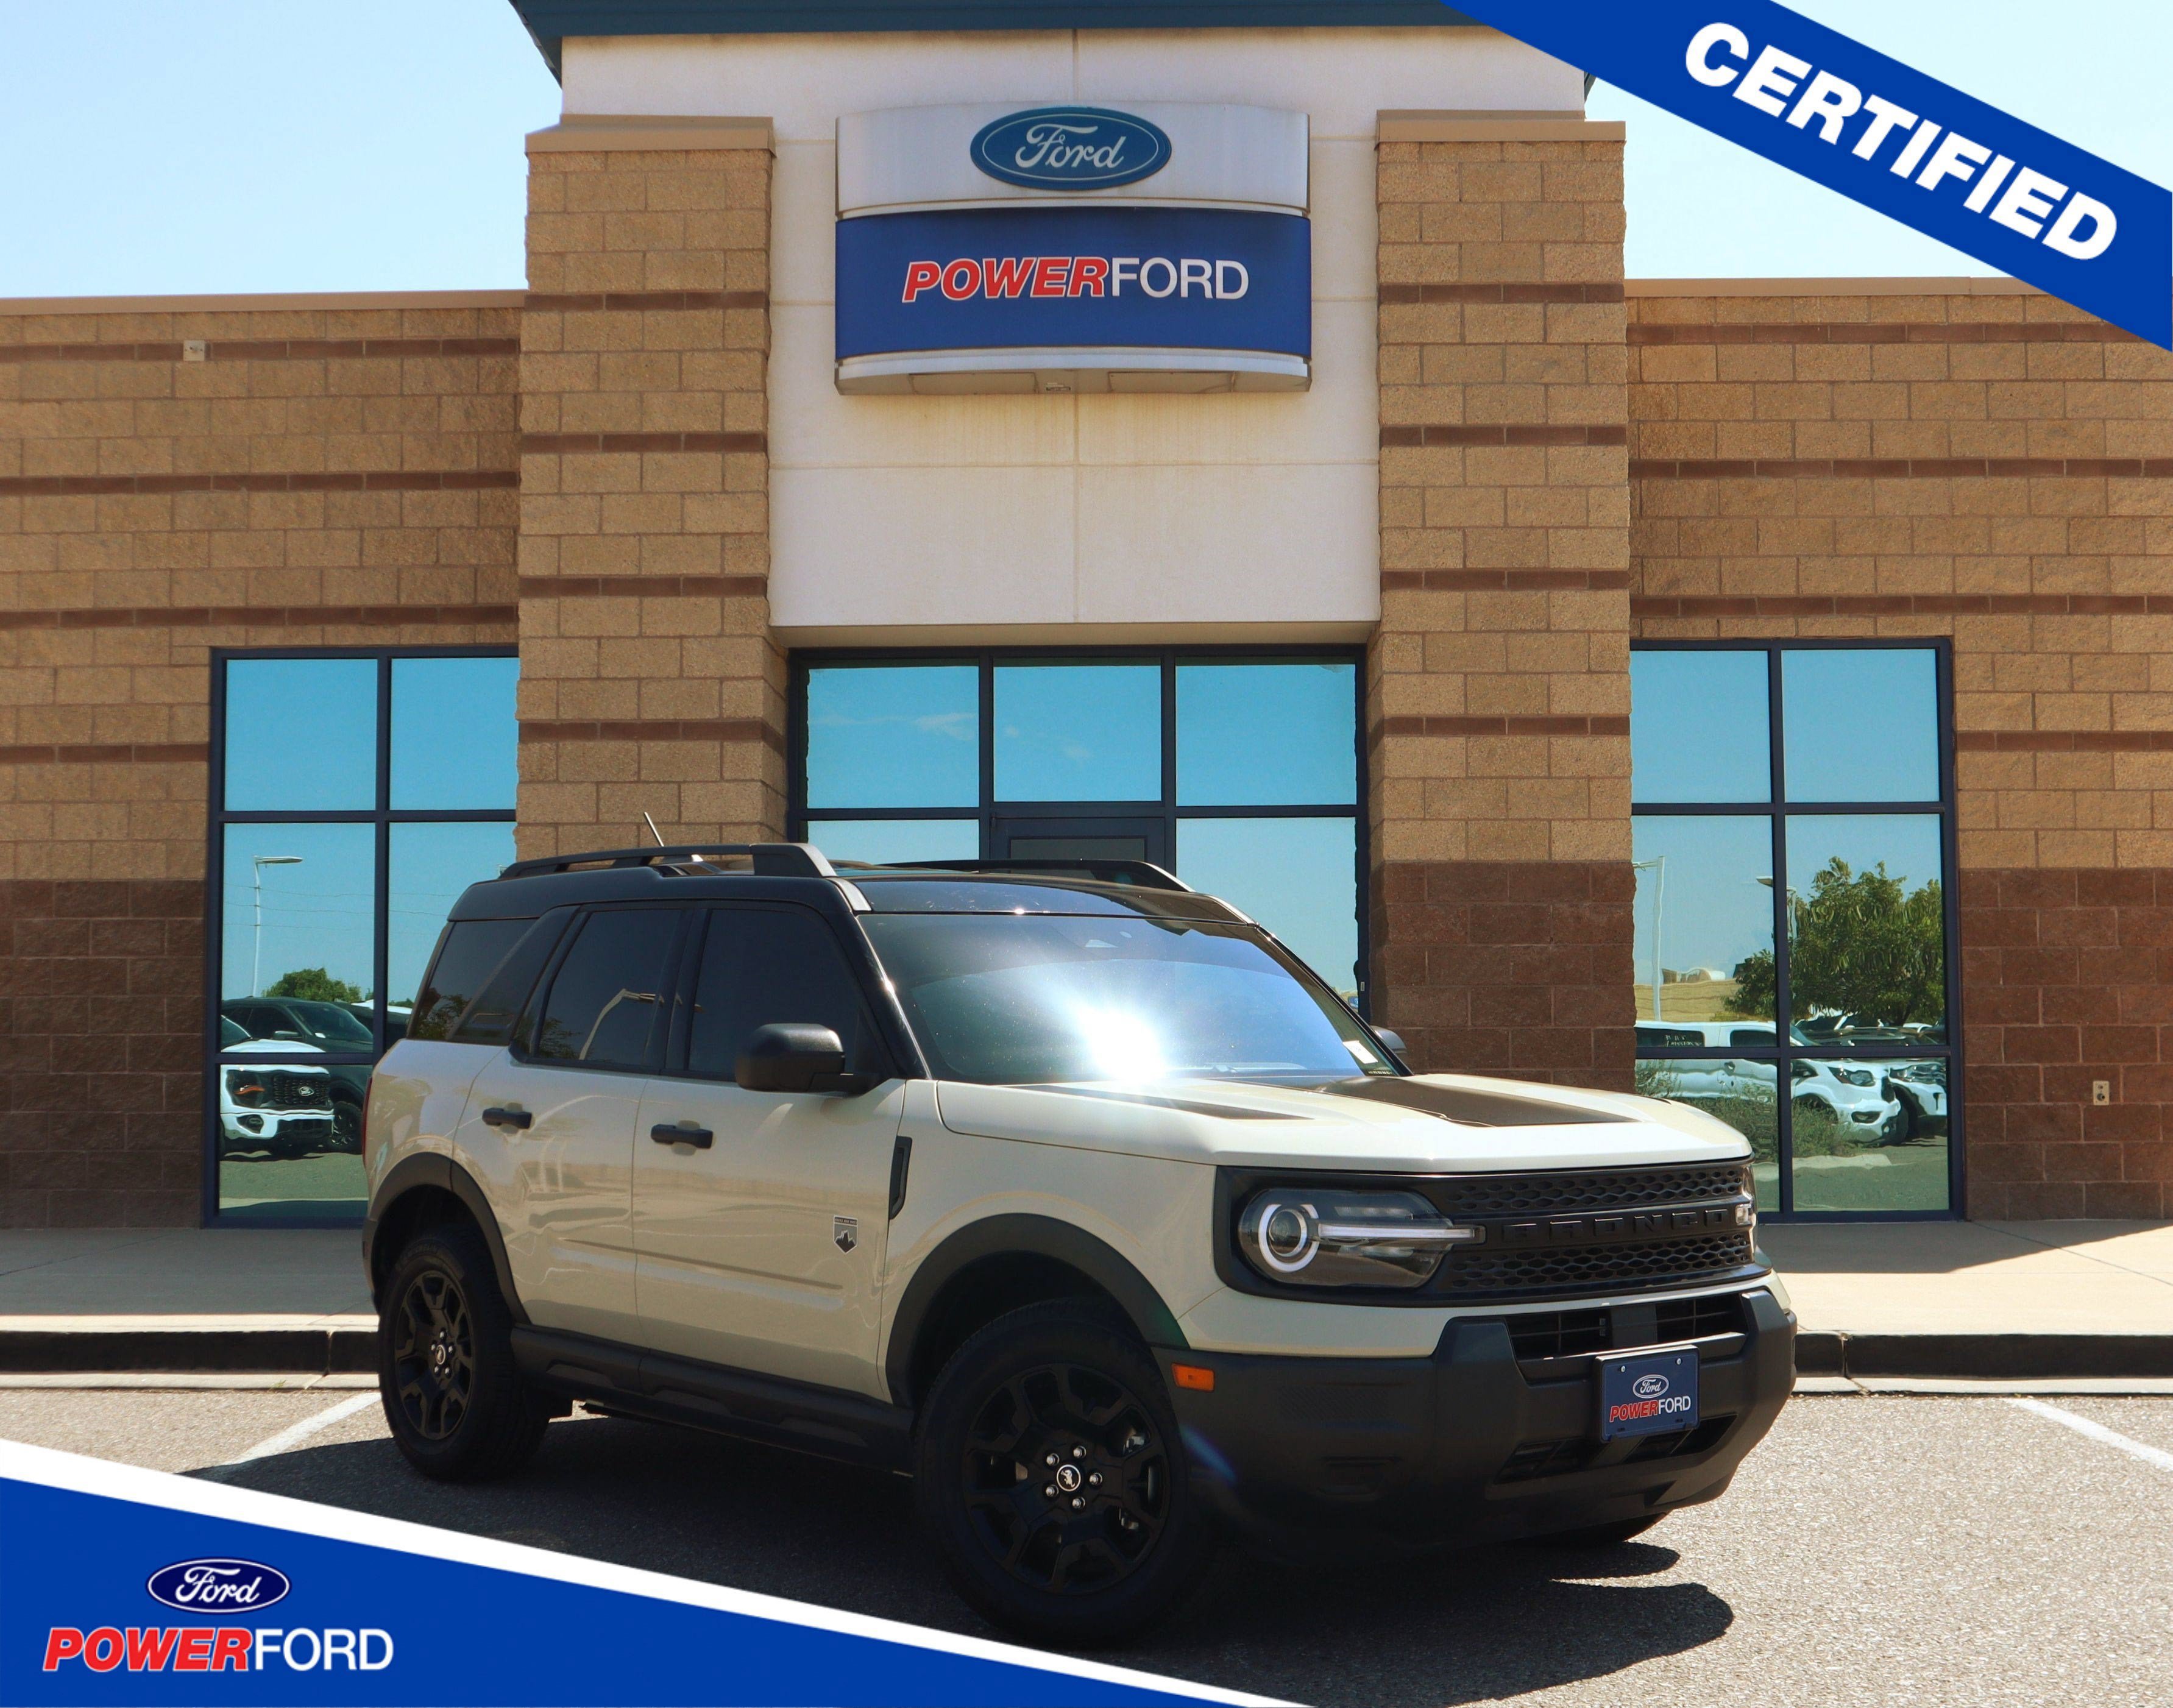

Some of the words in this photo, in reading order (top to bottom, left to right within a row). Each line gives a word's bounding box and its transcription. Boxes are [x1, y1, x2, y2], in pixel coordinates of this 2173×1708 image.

[1015, 123, 1127, 169] Ford
[902, 256, 1249, 303] POWERFORD
[1501, 1208, 1728, 1243] BRONCO
[1640, 1378, 1662, 1394] Ford
[1609, 1395, 1692, 1423] POWERFORD
